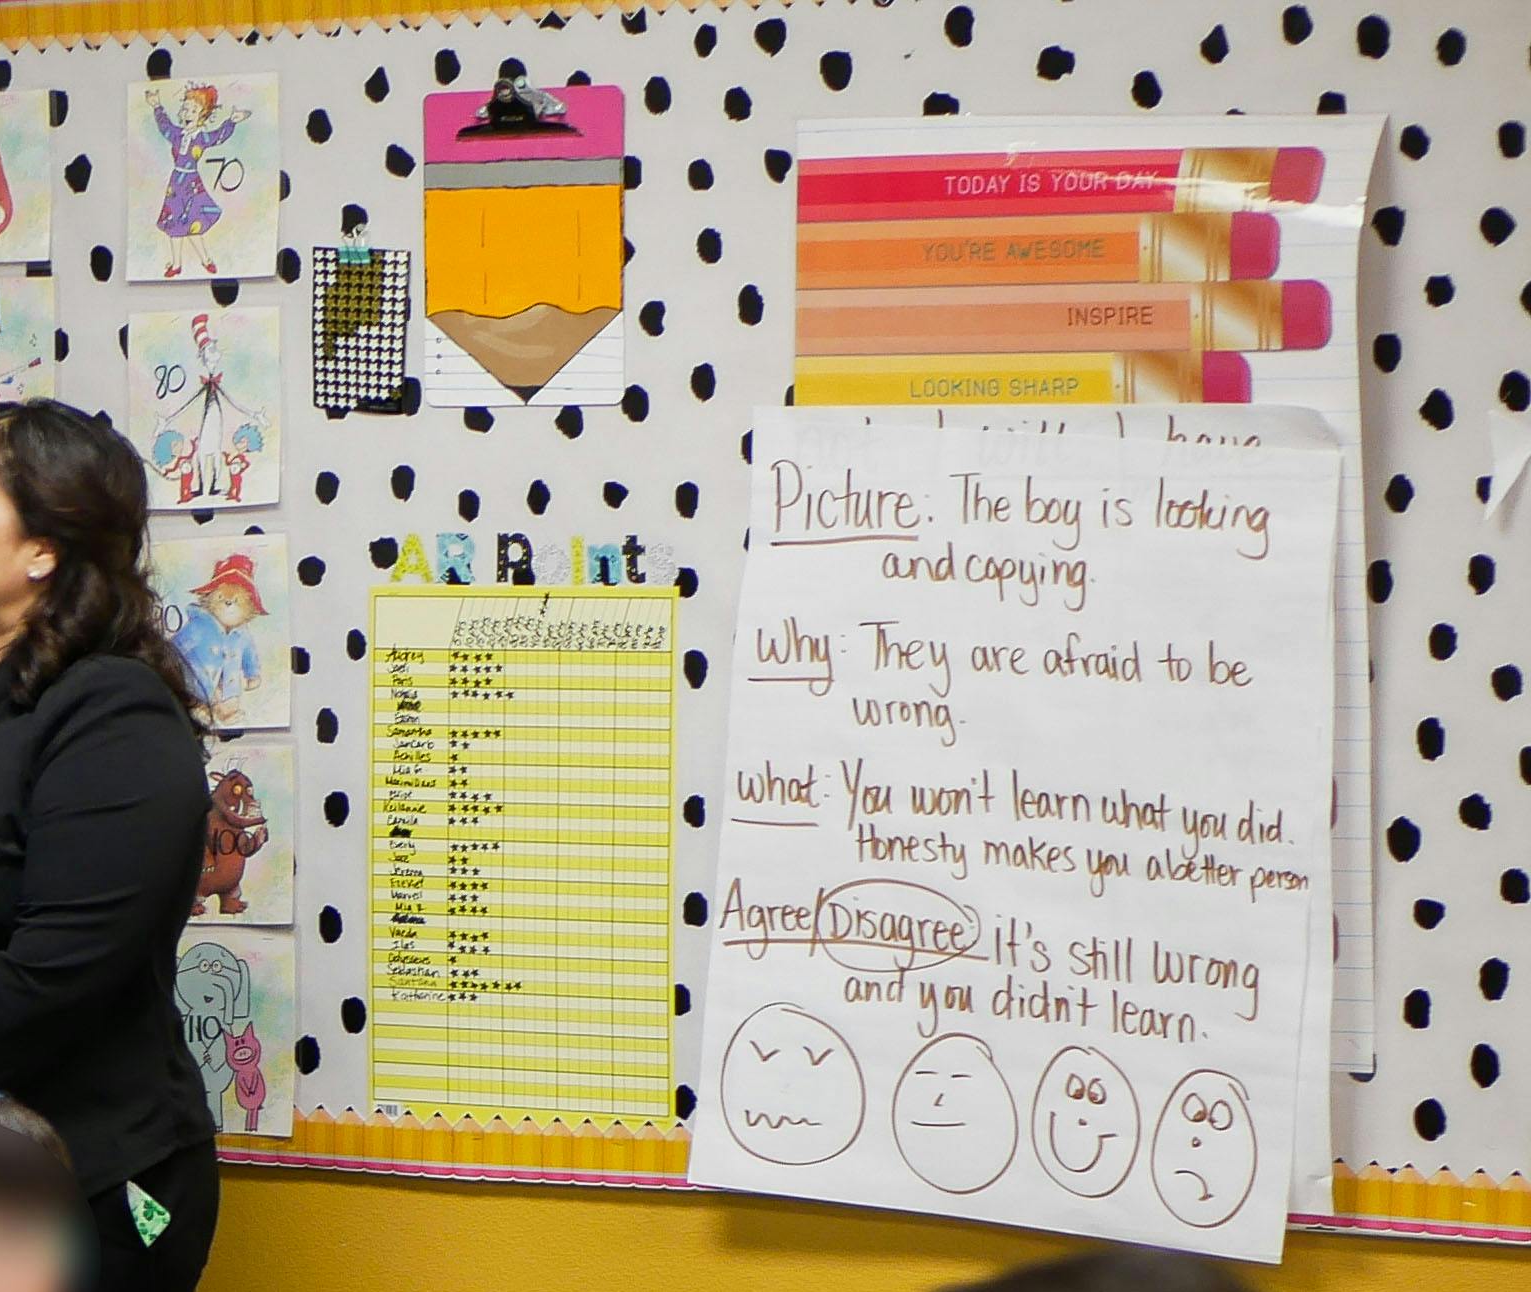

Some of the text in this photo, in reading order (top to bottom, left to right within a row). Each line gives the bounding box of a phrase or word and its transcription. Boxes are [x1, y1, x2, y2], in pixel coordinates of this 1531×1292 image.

[205, 157, 245, 193] 70
[944, 169, 1159, 195] TODAY IS YOUR DAY
[922, 237, 1106, 263] YOU'RE AWESOME
[1067, 306, 1154, 326] INSPIRE
[155, 364, 187, 397] 80
[909, 377, 1079, 399] LOOKING SHARP
[949, 472, 1011, 524] The
[1025, 476, 1082, 550] boy
[1101, 488, 1134, 528] is
[1154, 477, 1271, 559] looking
[394, 532, 475, 584] AR
[882, 541, 1095, 611] and copying.
[859, 620, 953, 698] They
[970, 645, 1030, 676] are
[1044, 632, 1142, 683] afraid
[1158, 655, 1192, 683] to
[1209, 641, 1254, 688] be
[841, 757, 893, 831] You
[910, 769, 996, 816] won't
[1011, 769, 1092, 823] learn
[1101, 789, 1172, 831] what
[1181, 807, 1228, 857] you
[855, 822, 968, 879] Honesty
[983, 834, 1077, 874] makes
[1086, 849, 1132, 896] you
[1250, 868, 1310, 903] person
[994, 914, 1052, 973] it's
[1068, 935, 1134, 985] still
[1153, 940, 1260, 1021] wrong
[845, 968, 905, 1003] and
[918, 982, 974, 1038] you
[992, 975, 1099, 1022] didn't
